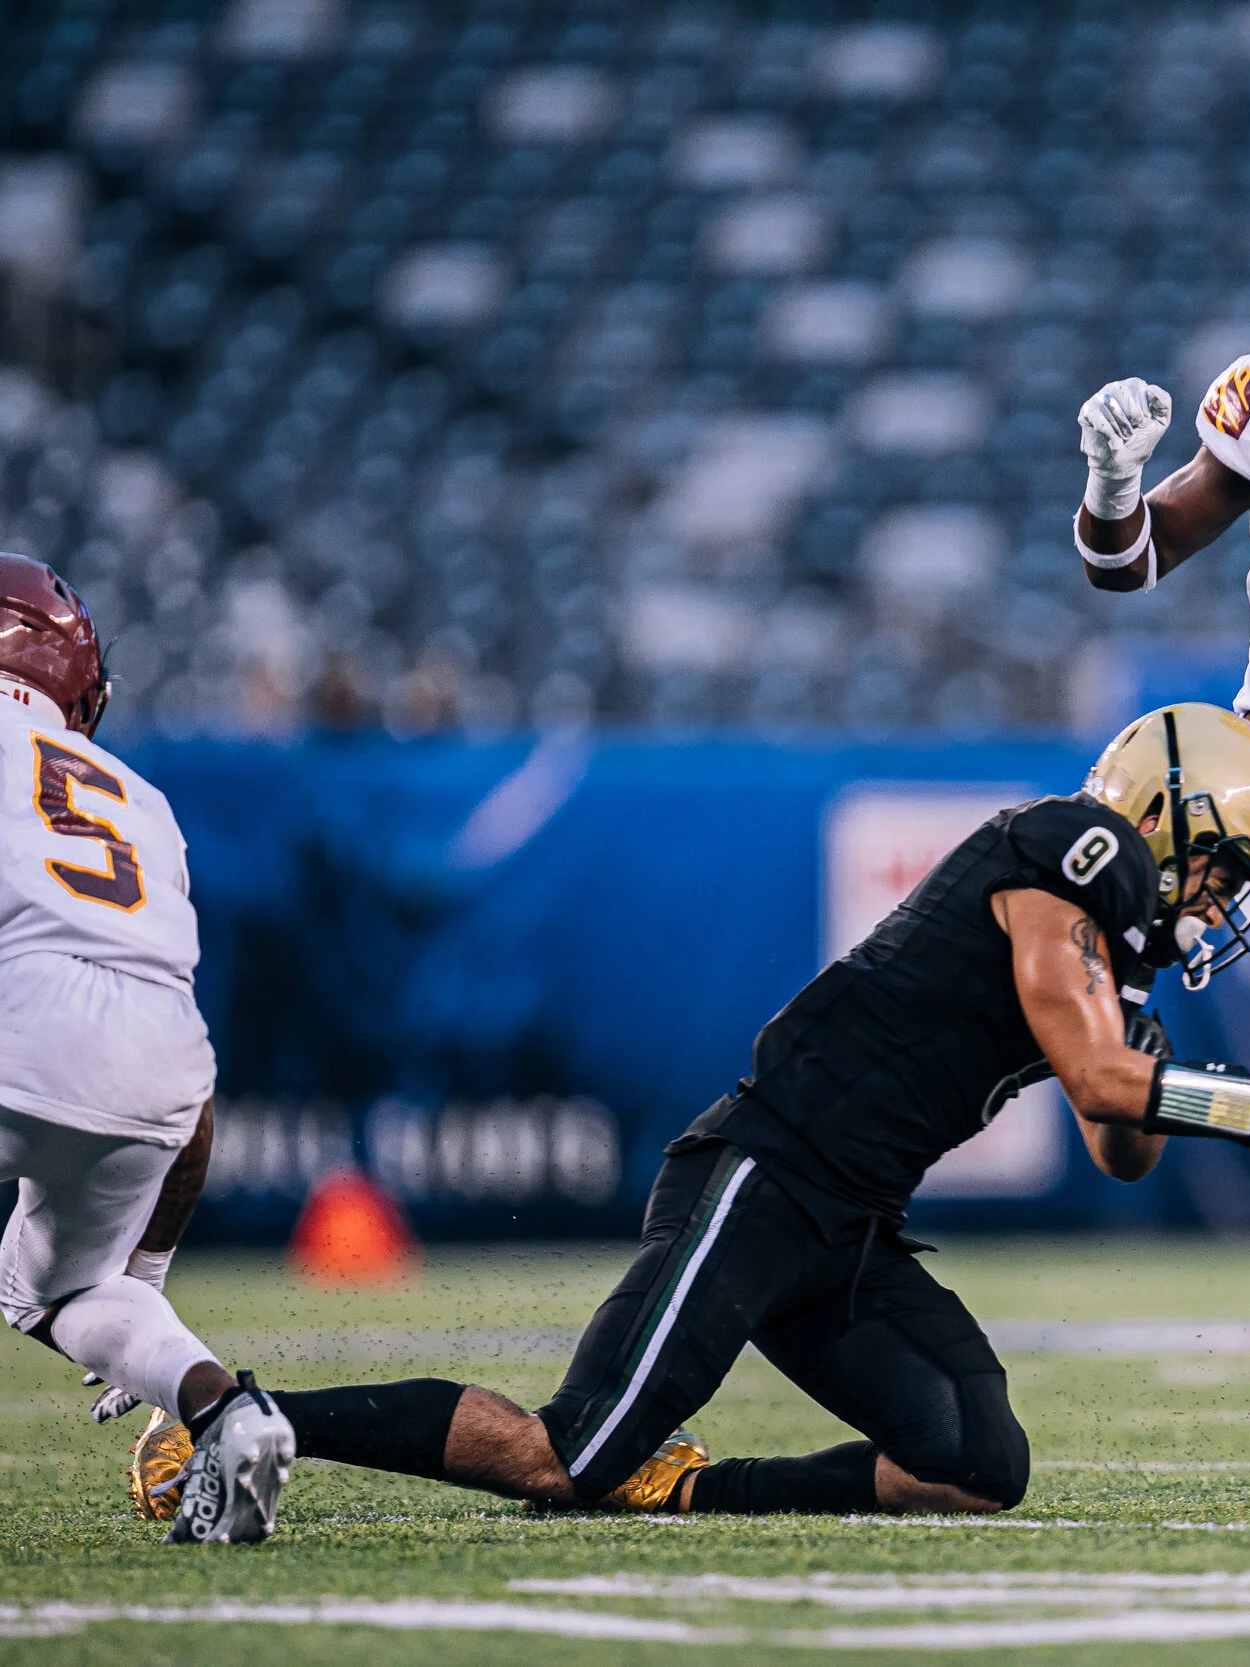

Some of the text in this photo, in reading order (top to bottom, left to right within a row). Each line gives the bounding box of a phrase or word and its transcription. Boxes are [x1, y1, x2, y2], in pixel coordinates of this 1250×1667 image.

[30, 731, 148, 914] 5
[1061, 826, 1119, 887] 9
[191, 1441, 221, 1539] adidas
